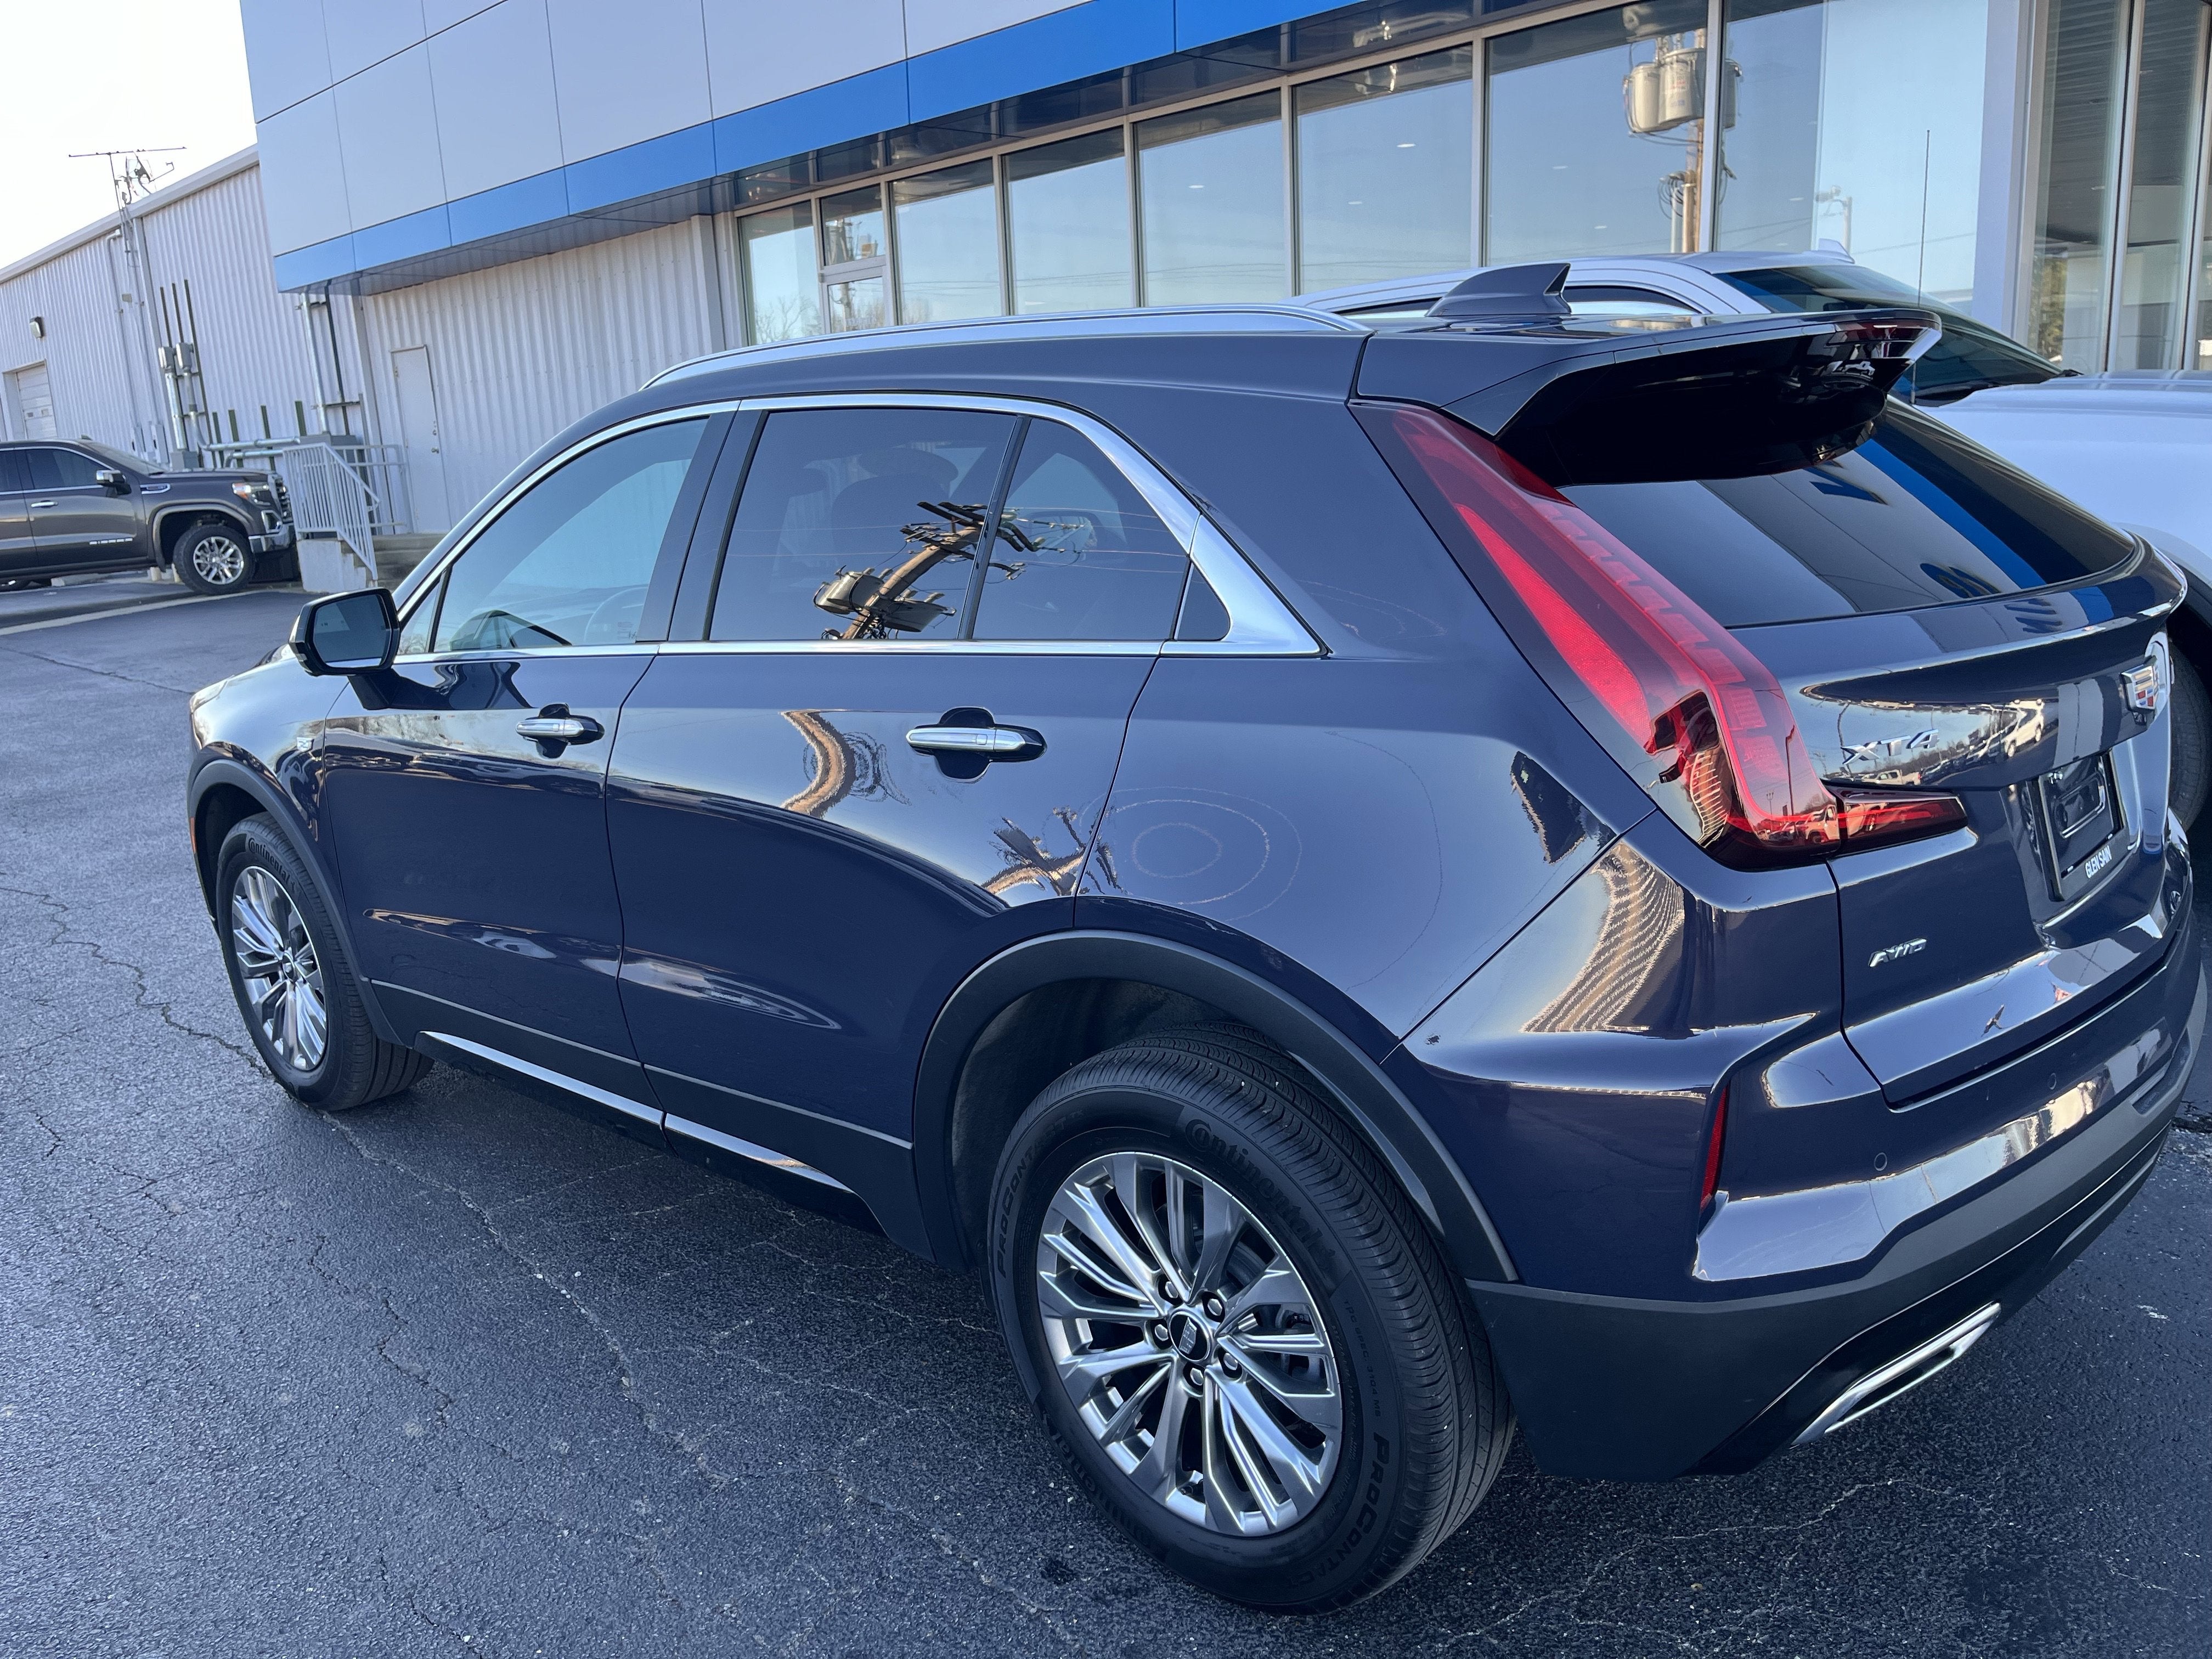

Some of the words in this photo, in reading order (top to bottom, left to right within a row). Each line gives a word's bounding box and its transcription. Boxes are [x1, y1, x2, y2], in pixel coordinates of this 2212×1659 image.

[1841, 729, 1940, 764] XT4
[249, 837, 290, 886] Continental
[2085, 854, 2101, 878] GLEN
[2098, 845, 2112, 867] SAIN
[1867, 938, 1927, 967] AWD
[1185, 1119, 1323, 1248] Continental
